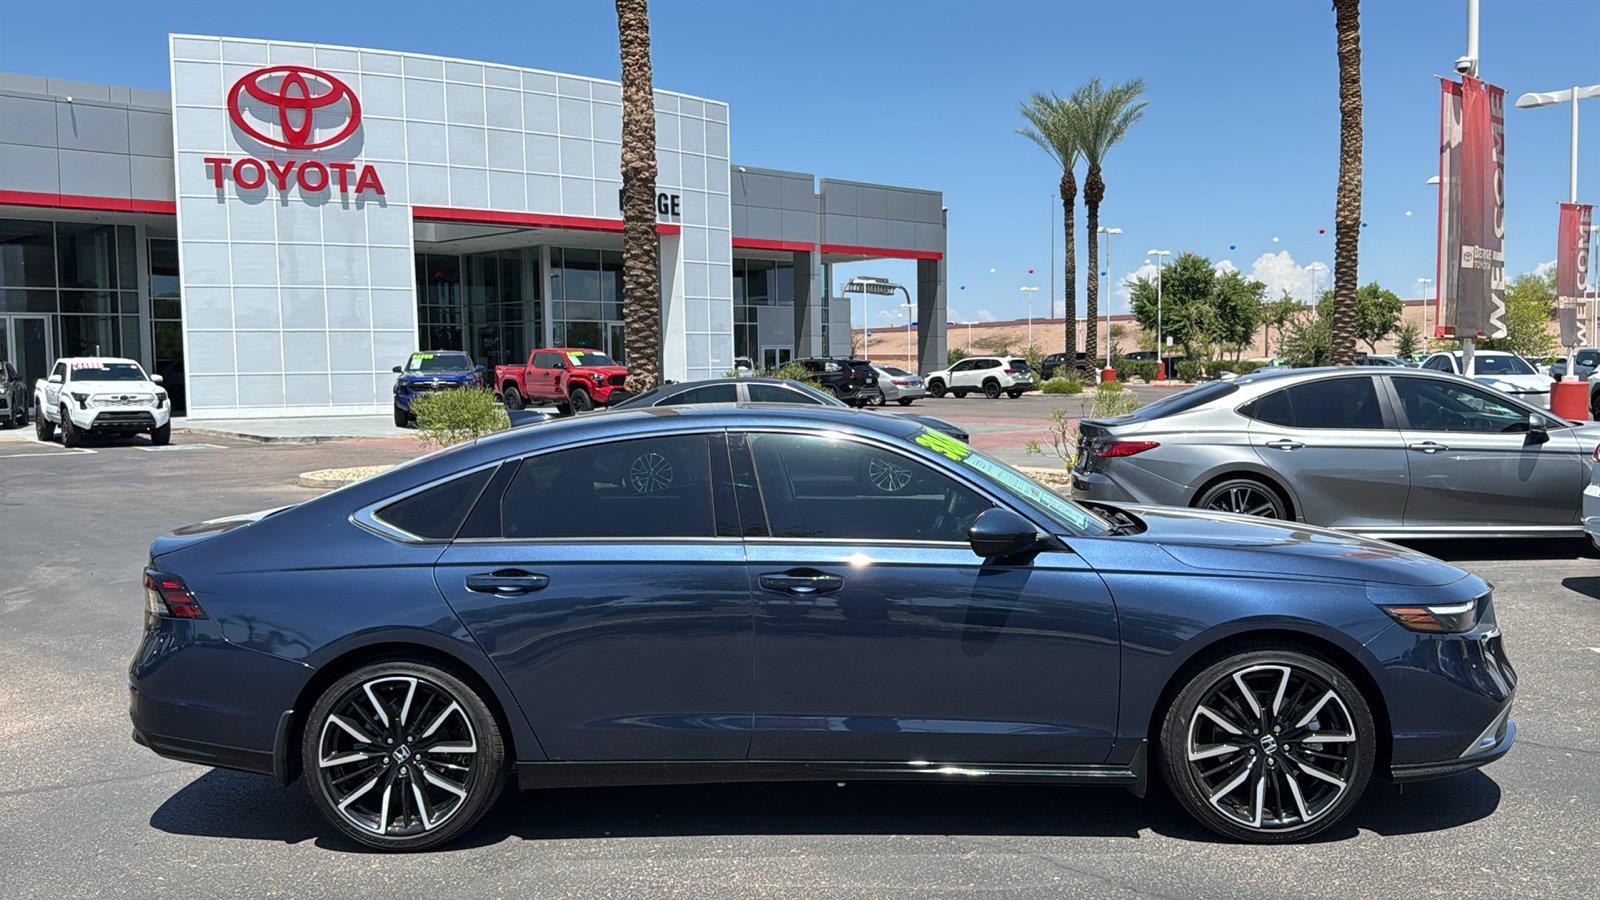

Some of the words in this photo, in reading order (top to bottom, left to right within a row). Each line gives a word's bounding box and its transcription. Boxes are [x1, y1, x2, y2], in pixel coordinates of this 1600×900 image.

[204, 157, 386, 196] TOYOTA
[1489, 91, 1508, 340] WELCOME
[1576, 208, 1593, 347] WELCOME
